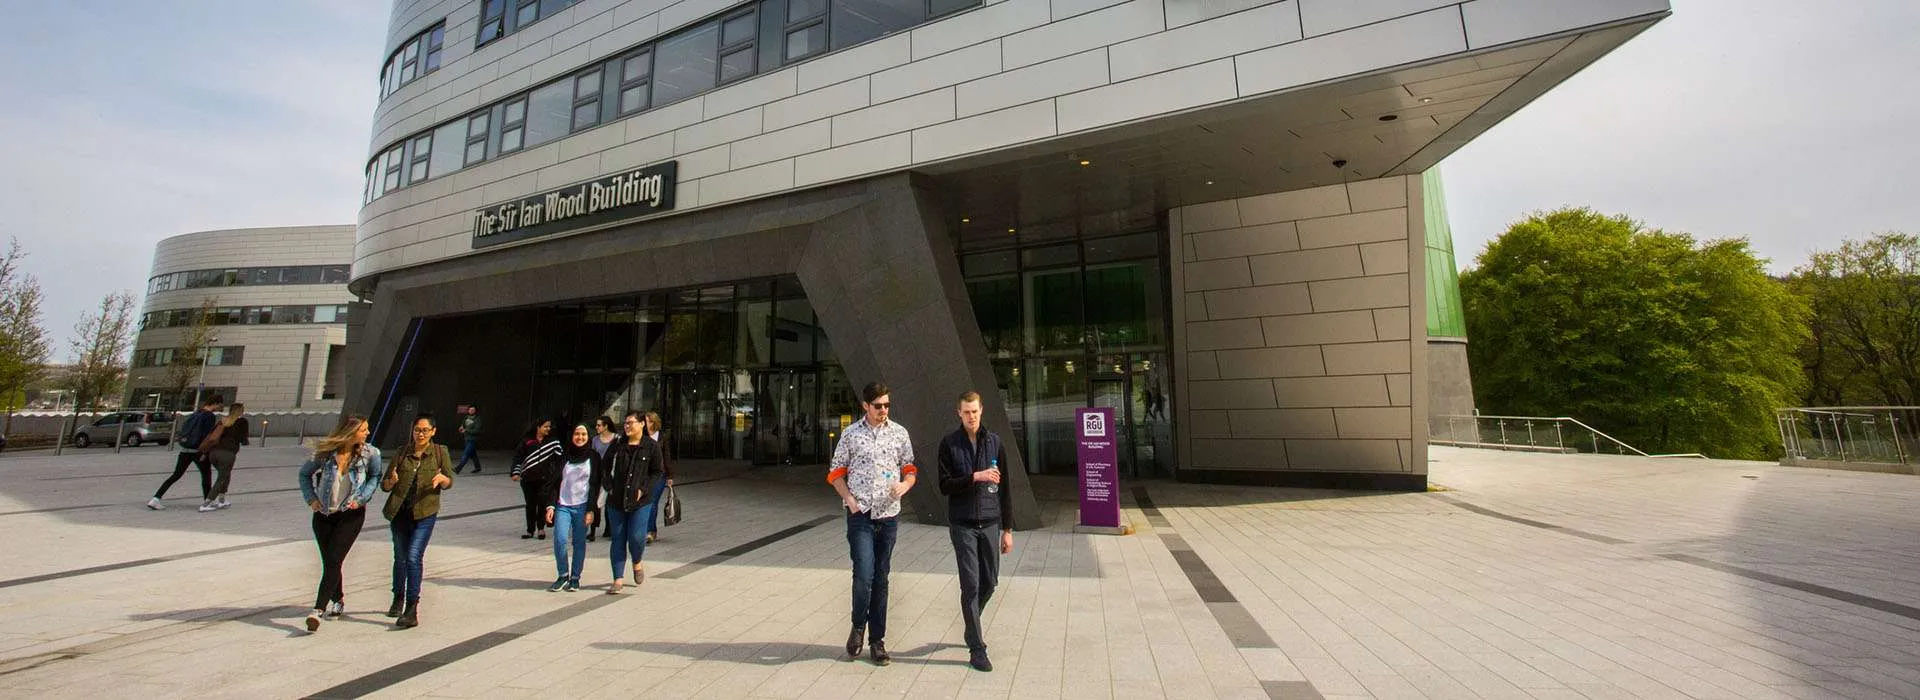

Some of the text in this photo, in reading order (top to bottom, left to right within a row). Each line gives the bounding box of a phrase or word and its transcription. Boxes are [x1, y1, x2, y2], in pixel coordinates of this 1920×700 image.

[474, 171, 662, 237] The Sir Ian Wood Building
[1086, 421, 1102, 429] RGU
